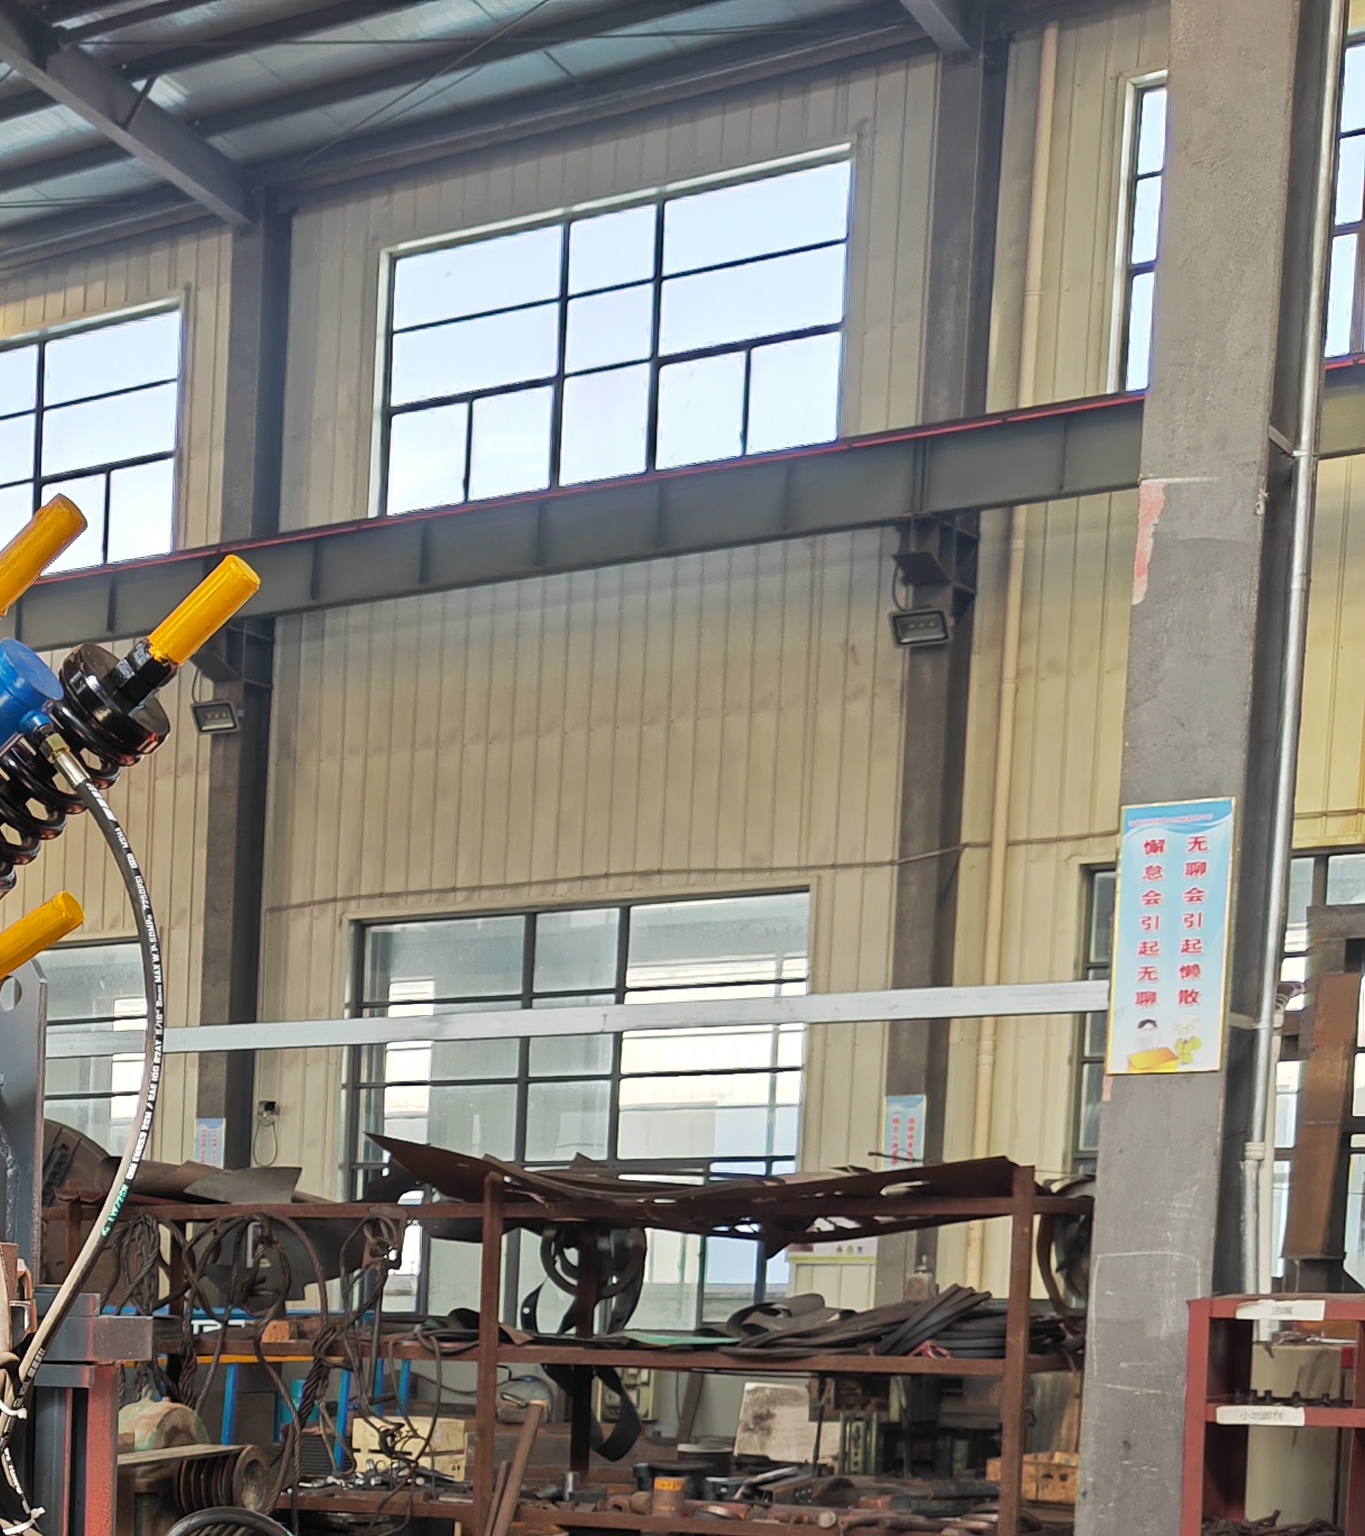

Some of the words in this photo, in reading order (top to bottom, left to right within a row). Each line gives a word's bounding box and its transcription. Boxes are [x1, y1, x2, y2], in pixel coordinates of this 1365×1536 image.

[152, 964, 162, 983] MAX
[1134, 838, 1166, 1008] 懈怠会引起无聊
[1177, 835, 1209, 1007] 无聊会引起懒散
